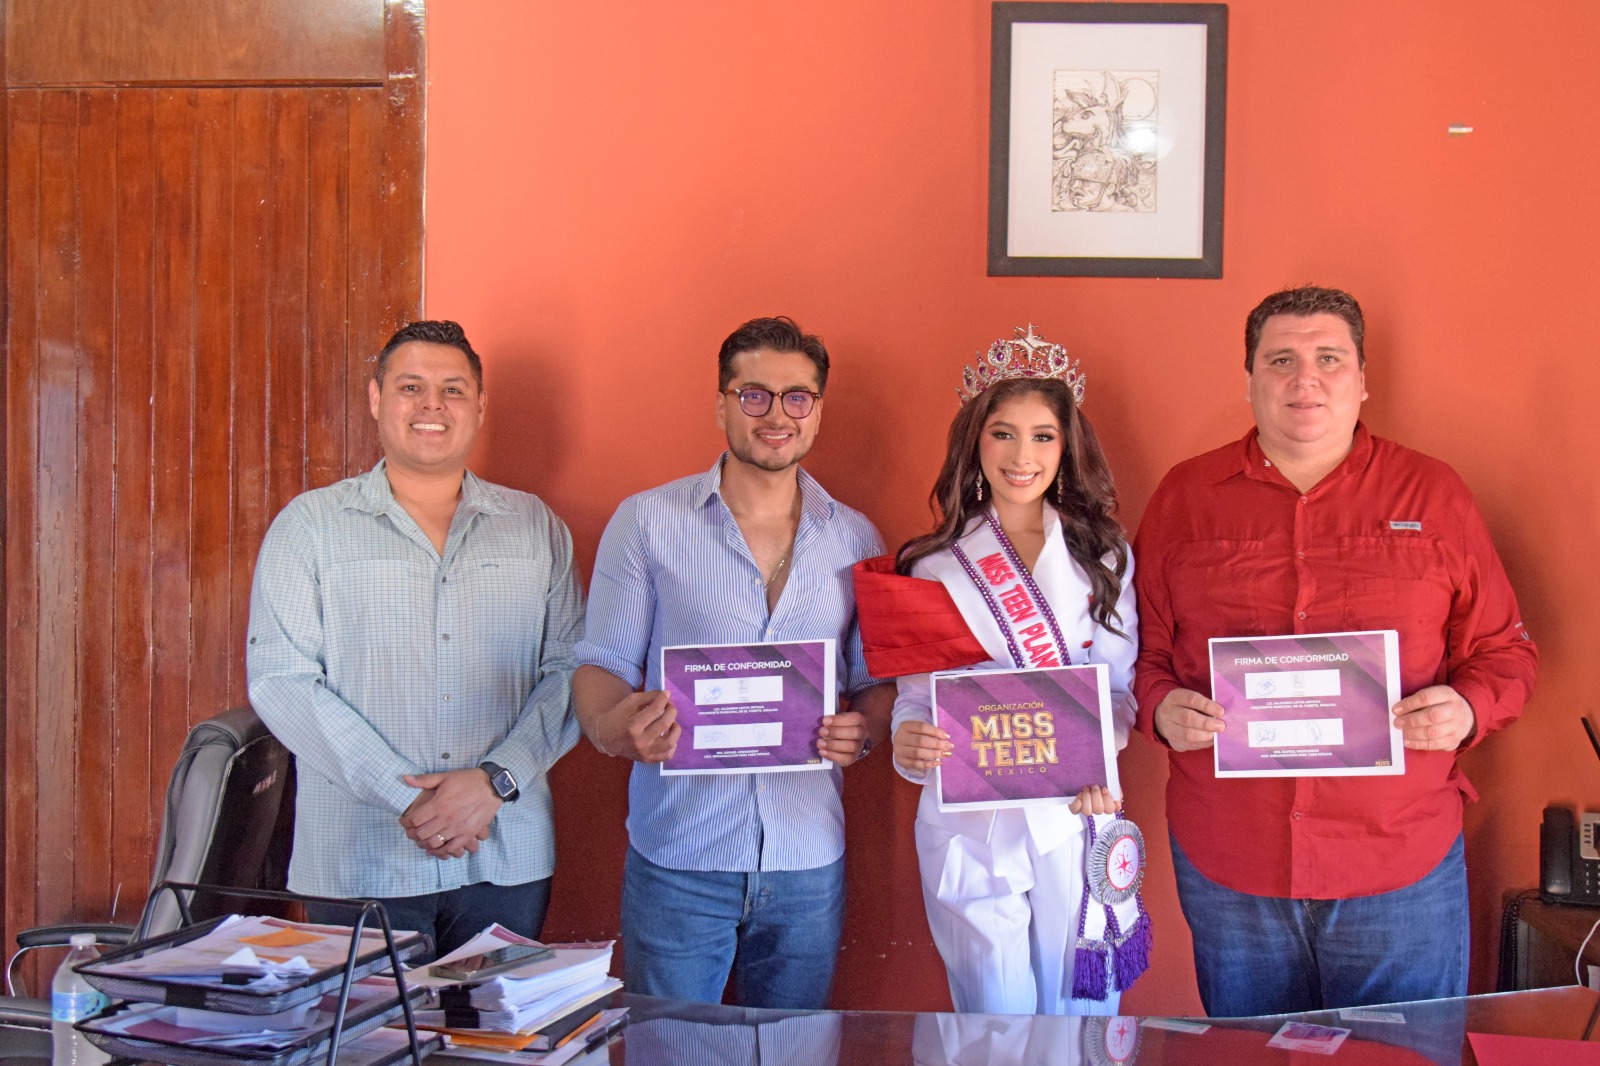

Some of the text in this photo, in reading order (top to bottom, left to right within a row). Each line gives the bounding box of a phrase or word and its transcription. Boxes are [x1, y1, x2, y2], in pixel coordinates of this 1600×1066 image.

[976, 552, 1060, 668] MISS TEEN PLAN
[684, 660, 792, 673] FIRMA DE CONFORMIDAD
[1234, 653, 1349, 666] FIRMA DE CONFORMIDAD
[978, 701, 1044, 713] ORGANIZACIÓN
[970, 711, 1055, 741] MISS
[971, 738, 1059, 768] TEEN
